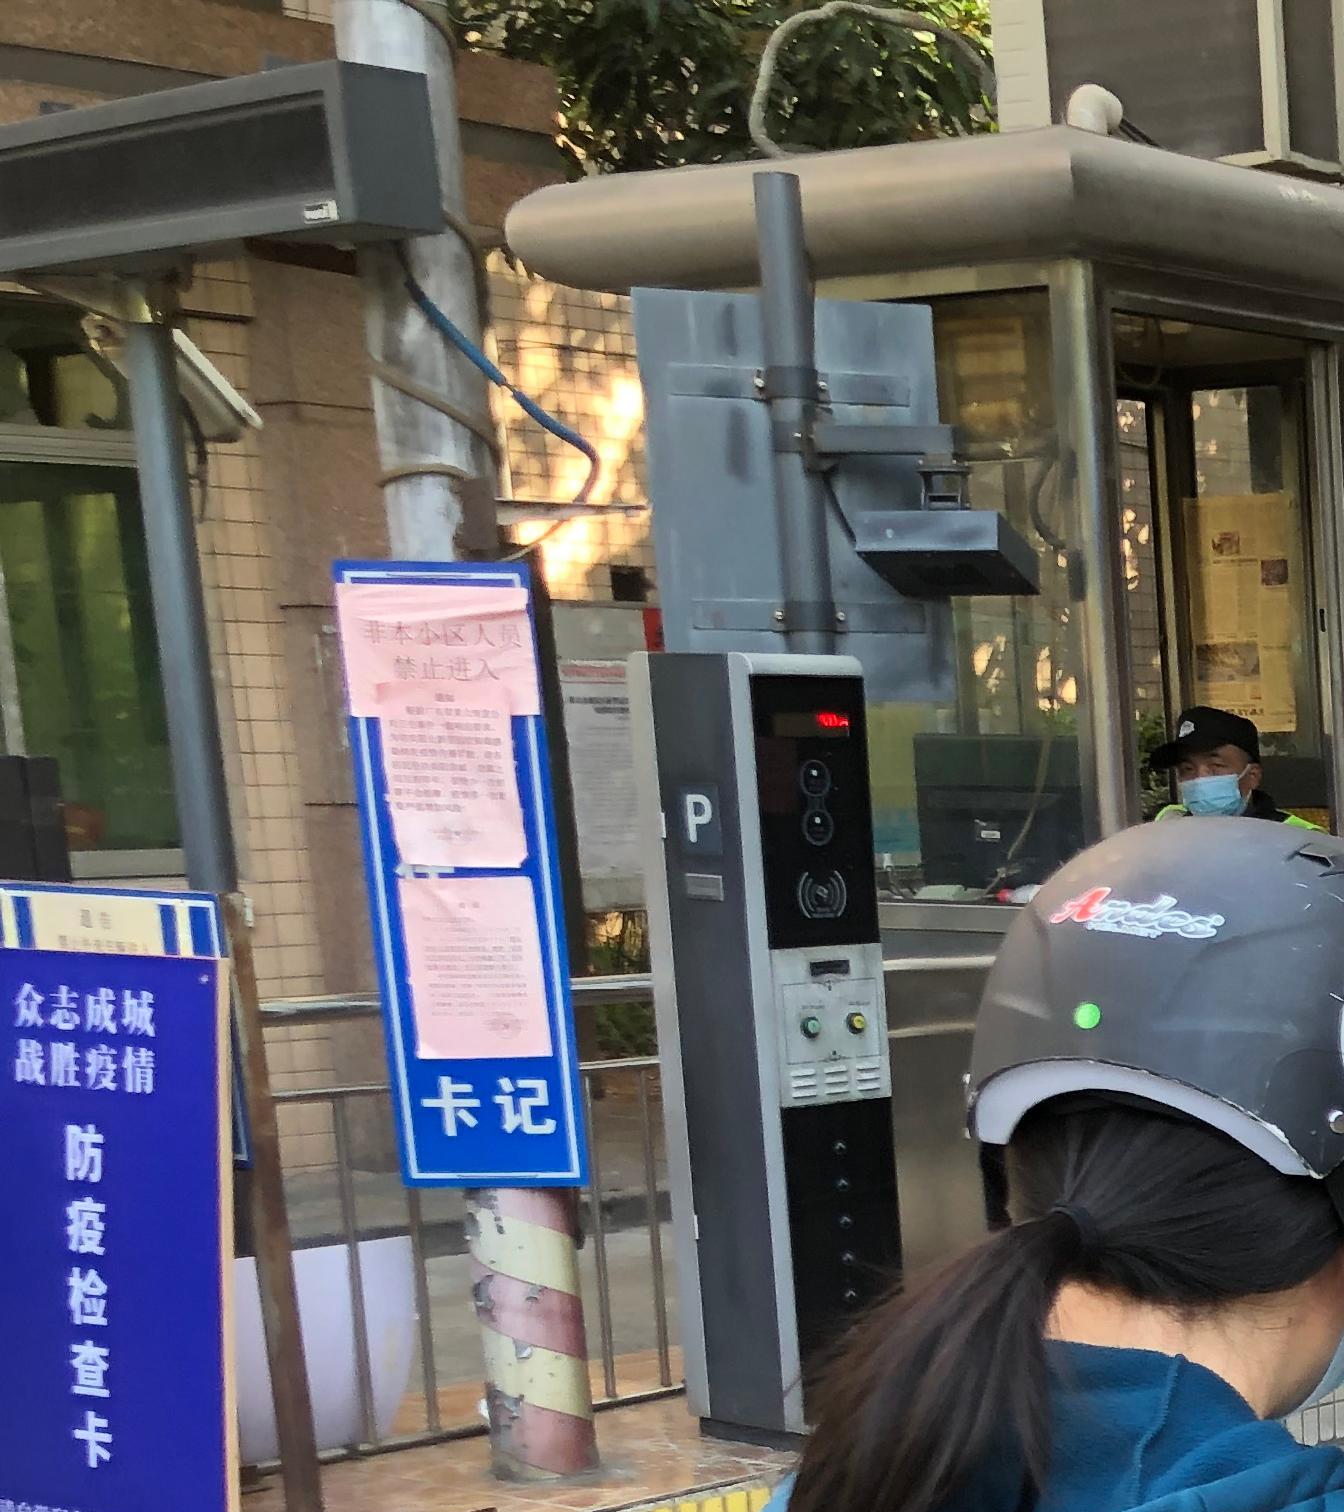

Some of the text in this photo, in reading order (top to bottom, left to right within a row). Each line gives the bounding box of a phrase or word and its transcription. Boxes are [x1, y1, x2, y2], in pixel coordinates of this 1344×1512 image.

[364, 620, 522, 650] 非本小区人员
[393, 655, 500, 682] 禁止进入
[685, 794, 711, 842] P
[14, 982, 156, 1038] 众志成城
[13, 1039, 155, 1094] 战胜疫情
[64, 1123, 114, 1469] 防疫检查卡
